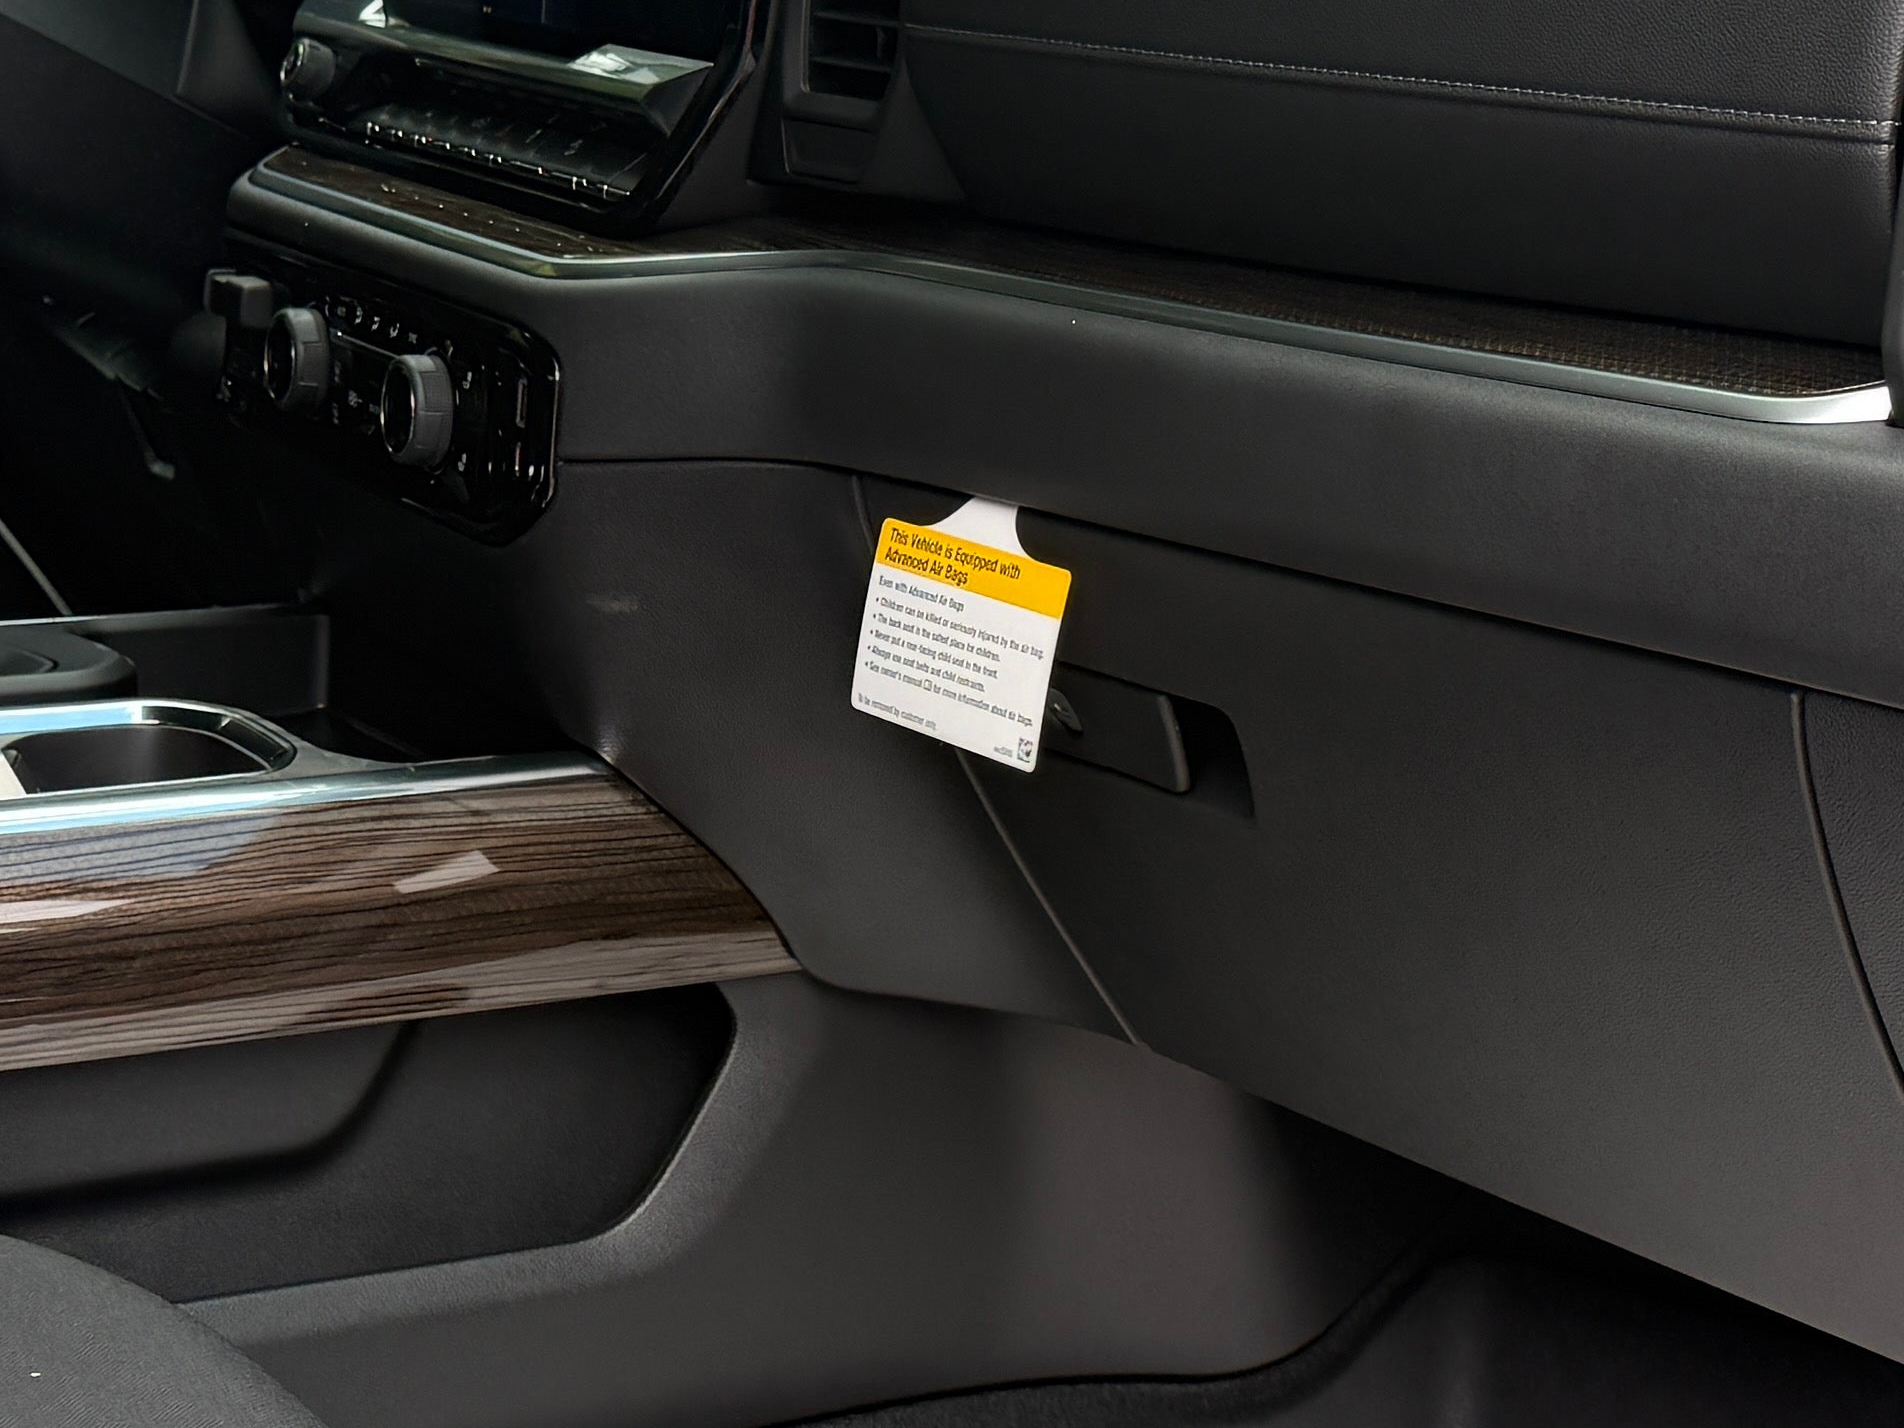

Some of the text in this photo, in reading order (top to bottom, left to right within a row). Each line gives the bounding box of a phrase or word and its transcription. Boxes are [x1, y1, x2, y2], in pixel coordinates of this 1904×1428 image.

[884, 546, 969, 587] Advanced Air Bags
[890, 528, 1021, 579] This Vehicle is Equipped with
